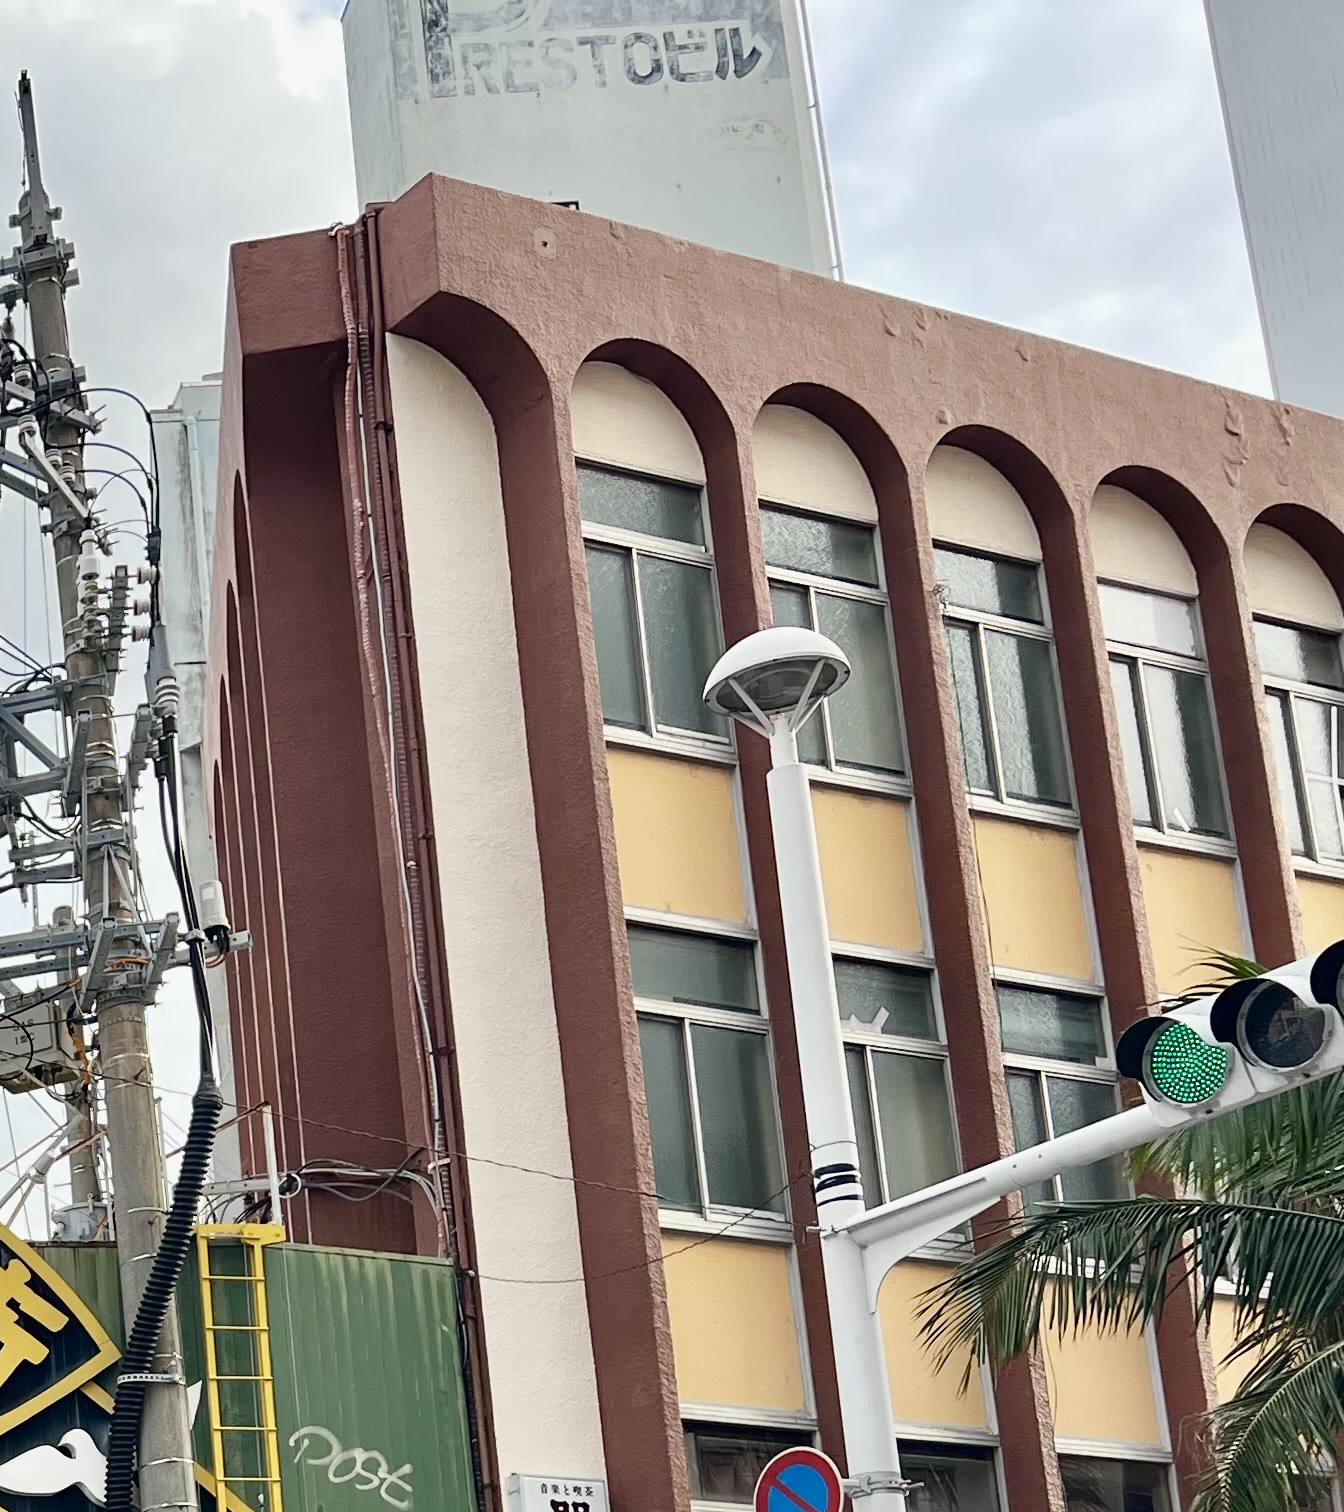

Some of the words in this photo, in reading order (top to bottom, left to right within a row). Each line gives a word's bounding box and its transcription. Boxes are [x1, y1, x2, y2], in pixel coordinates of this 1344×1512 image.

[539, 1482, 595, 1498] 音楽と喫茶
